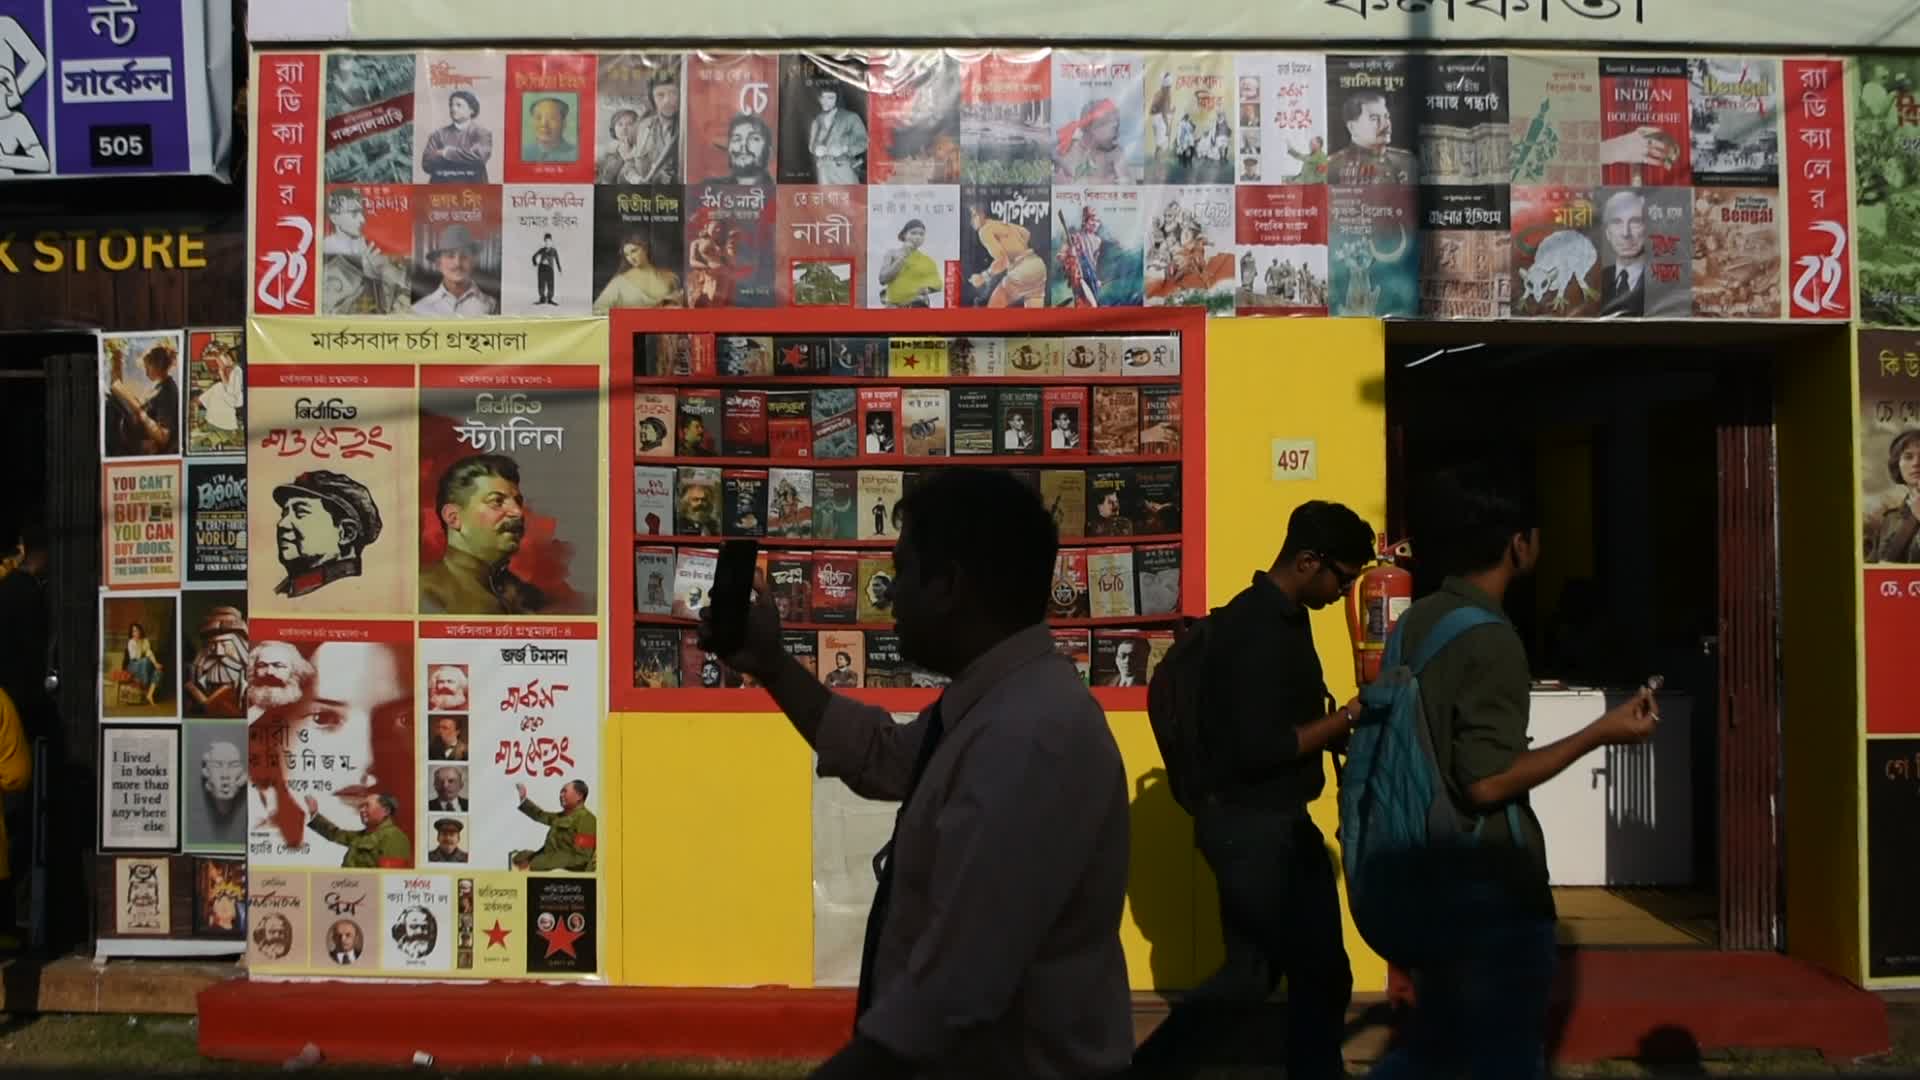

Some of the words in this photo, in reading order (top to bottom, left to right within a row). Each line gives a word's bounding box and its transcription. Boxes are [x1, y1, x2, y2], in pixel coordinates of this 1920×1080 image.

[64, 61, 172, 96] সার্কেল
[1633, 79, 1653, 90] THE
[1614, 88, 1673, 103] INDIAN
[1606, 111, 1682, 125] BOURGEOISIE
[99, 136, 144, 156] 505
[1721, 206, 1773, 224] Bengal
[791, 213, 853, 247] নারী
[33, 228, 209, 274] STORE
[311, 327, 400, 353] মার্কসবাদ
[405, 330, 437, 354] চর্চা
[446, 330, 529, 357] গ্রন্থমালা
[294, 397, 358, 421] নির্বাচিত
[475, 392, 543, 416] নির্বাচিত
[453, 418, 565, 457] স্ট্যালিন
[1277, 449, 1311, 471] 497
[113, 476, 137, 491] YOU
[139, 475, 174, 490] CAN'T
[114, 502, 148, 524] BUT
[113, 524, 142, 543] YOU
[144, 522, 175, 542] CAN
[197, 530, 236, 547] WORLD
[529, 643, 569, 665] টমসন
[112, 752, 118, 764] I
[123, 750, 152, 764] lived
[121, 764, 133, 777] in
[135, 764, 169, 777] books
[111, 779, 141, 790] more
[143, 778, 170, 791] than
[124, 793, 129, 804] I
[133, 791, 163, 805] lived
[111, 807, 168, 821] anywhere
[143, 820, 167, 833] else
